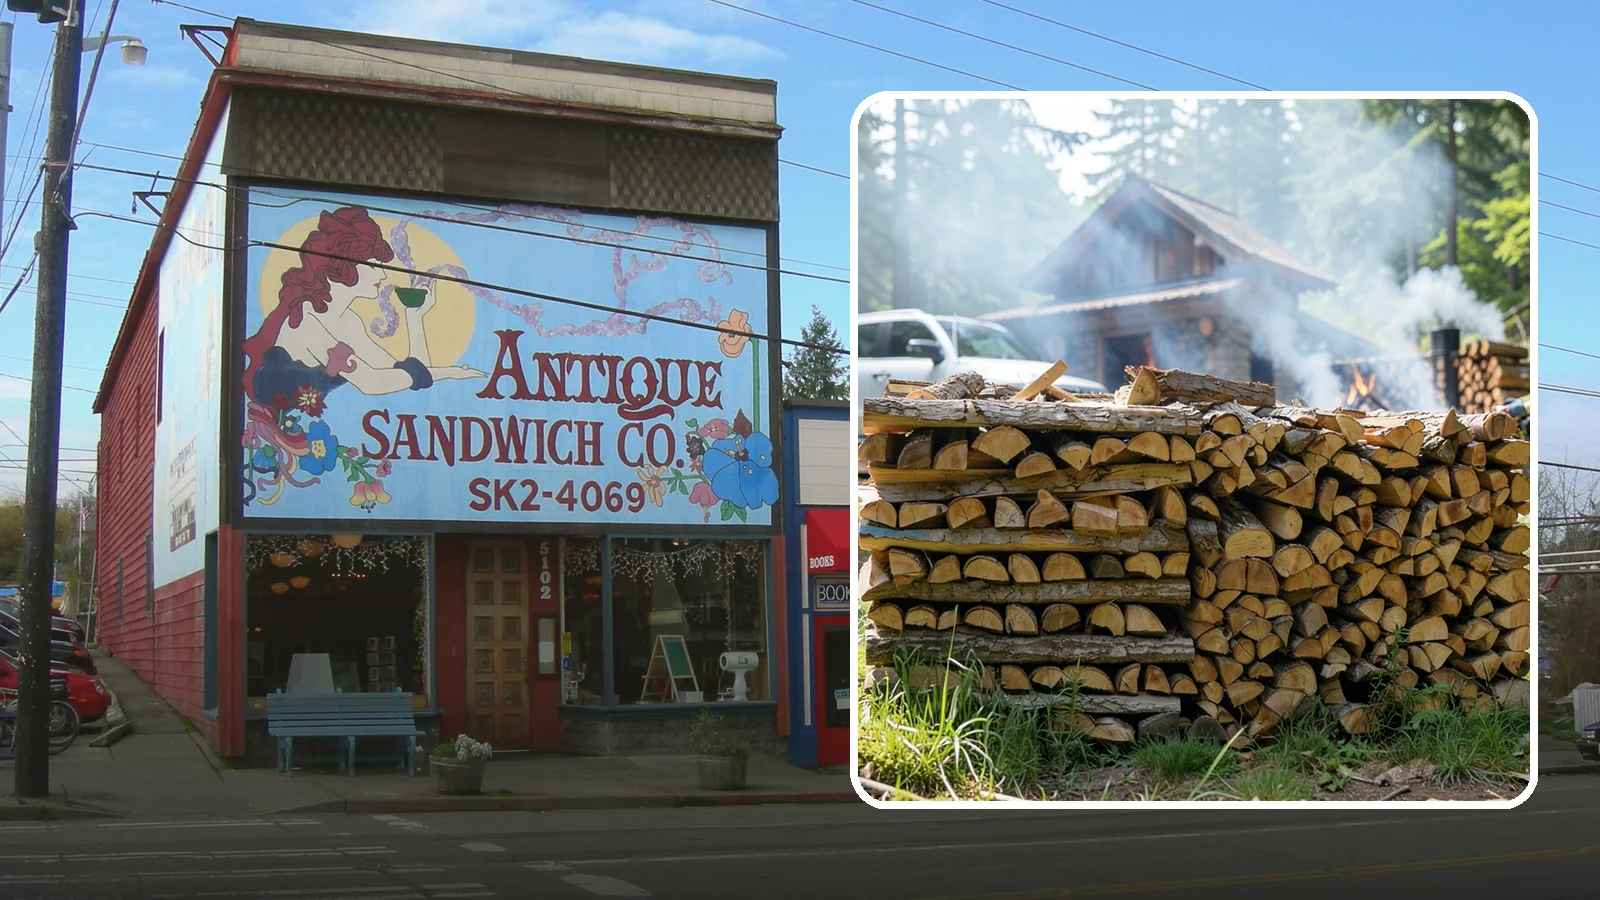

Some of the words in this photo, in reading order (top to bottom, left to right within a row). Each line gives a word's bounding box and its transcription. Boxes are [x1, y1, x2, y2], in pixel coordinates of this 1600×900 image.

[476, 329, 724, 420] ANTIQUE
[361, 408, 605, 467] SANDWICH
[617, 422, 685, 468] CO.
[468, 476, 646, 513] SK2-4069
[540, 541, 551, 600] 5102
[809, 555, 835, 569] BOOKS
